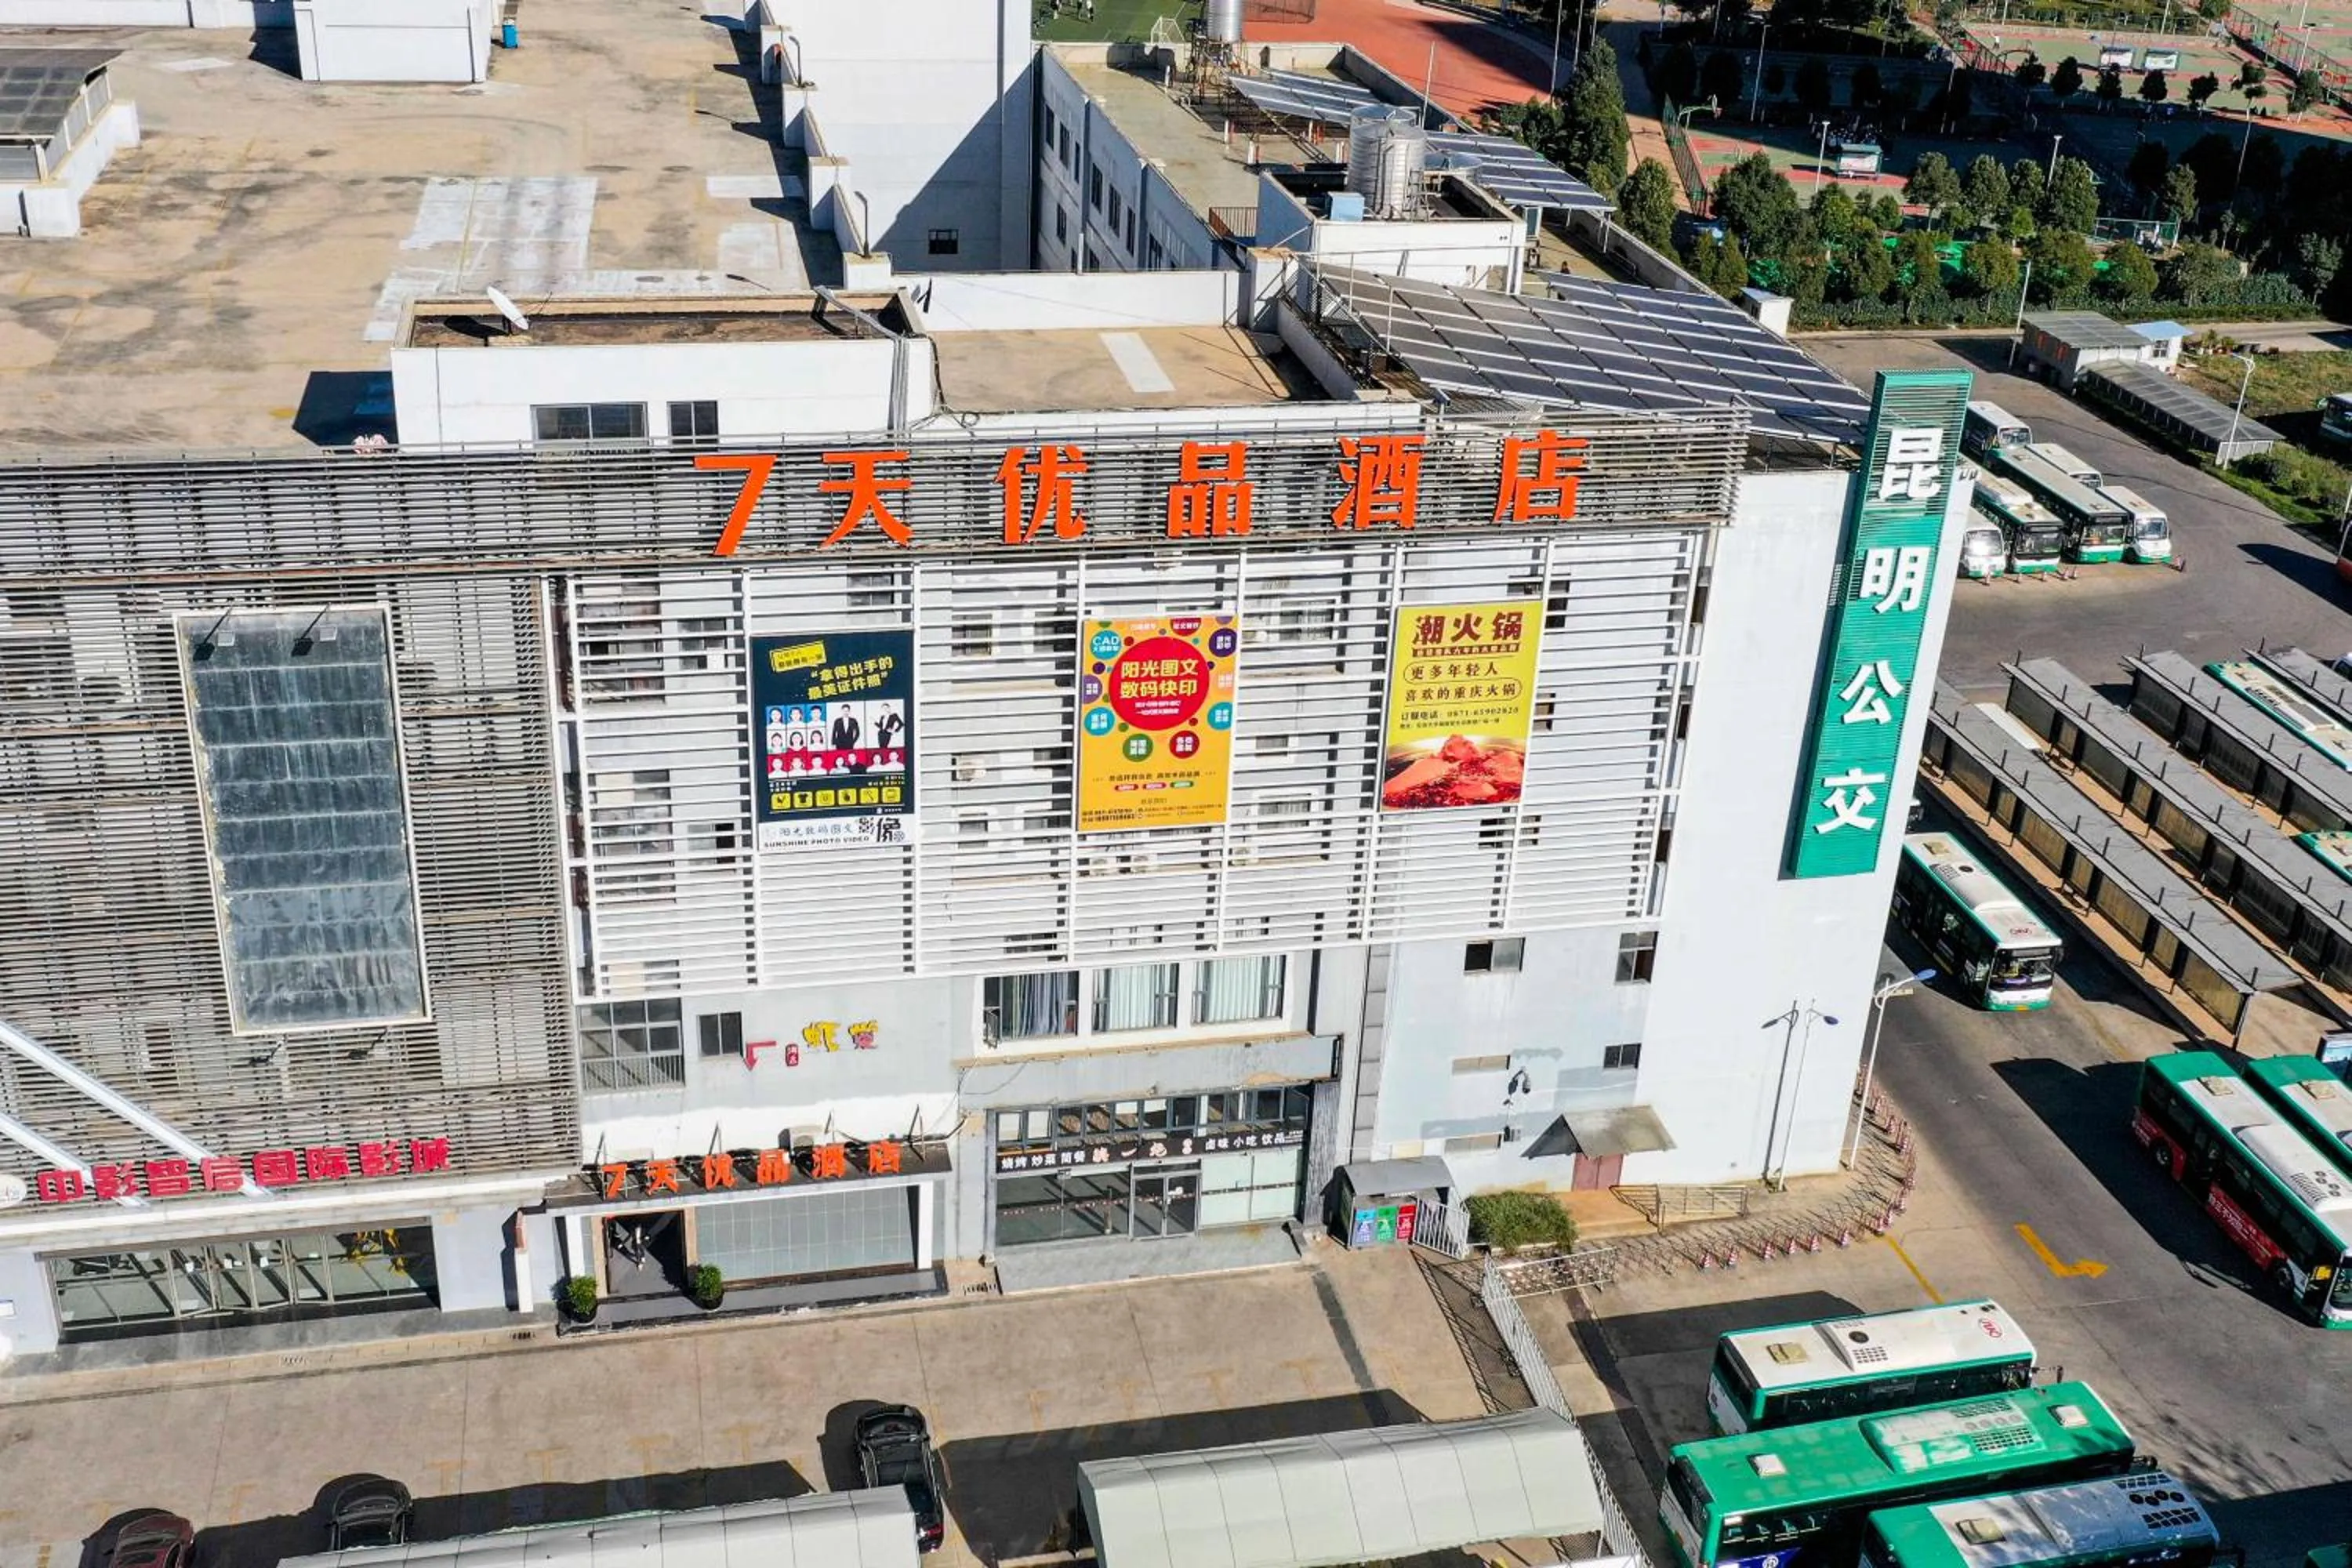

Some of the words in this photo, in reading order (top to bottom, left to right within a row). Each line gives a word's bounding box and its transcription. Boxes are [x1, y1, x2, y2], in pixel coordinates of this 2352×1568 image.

[694, 429, 1592, 556] 7天优品酒店
[1412, 610, 1523, 644] 潮火锅
[1814, 427, 1944, 834] 昆明公交
[1092, 636, 1120, 646] CAD
[1121, 659, 1199, 678] 阳光图文
[1411, 661, 1498, 681] 更多年轻人
[1120, 679, 1198, 699] 数码快印
[1406, 683, 1515, 702] 喜欢的重庆火锅
[601, 1139, 901, 1201] 7天优品酒店
